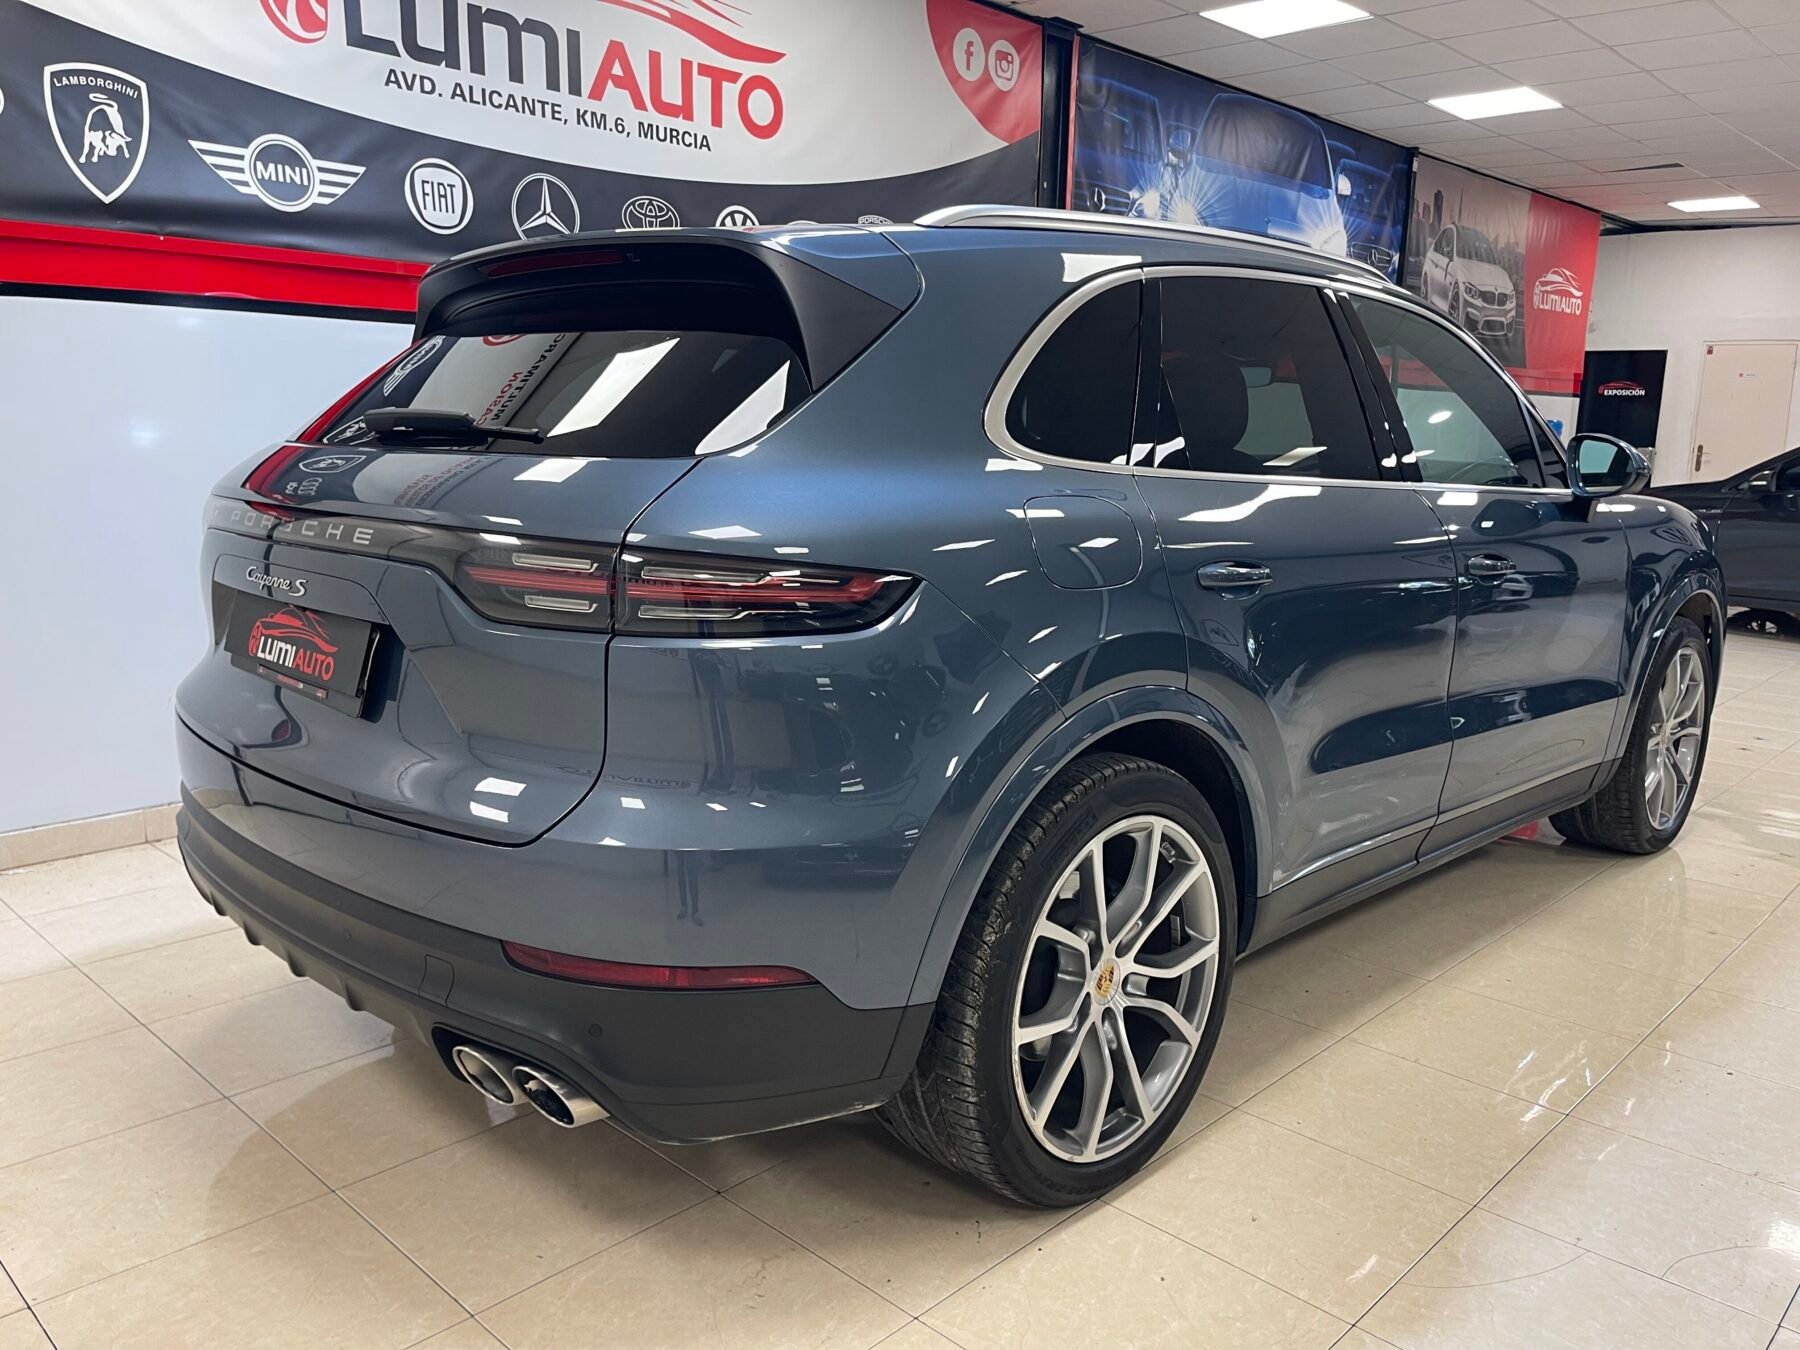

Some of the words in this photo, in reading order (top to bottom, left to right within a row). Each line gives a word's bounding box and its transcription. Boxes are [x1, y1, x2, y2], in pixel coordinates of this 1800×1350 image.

[53, 75, 139, 99] LAMBORGHINI
[384, 68, 443, 98] AVD.
[450, 82, 568, 125] ALICANTE,
[576, 108, 631, 138] KM.6,
[638, 121, 712, 151] MURCIA
[256, 161, 308, 186] MINI
[421, 179, 456, 214] FIAT
[1604, 388, 1646, 396] EXPOSICIÓN
[230, 510, 374, 545] PORSCHE
[246, 566, 291, 591] Cayenne
[288, 579, 306, 597] S
